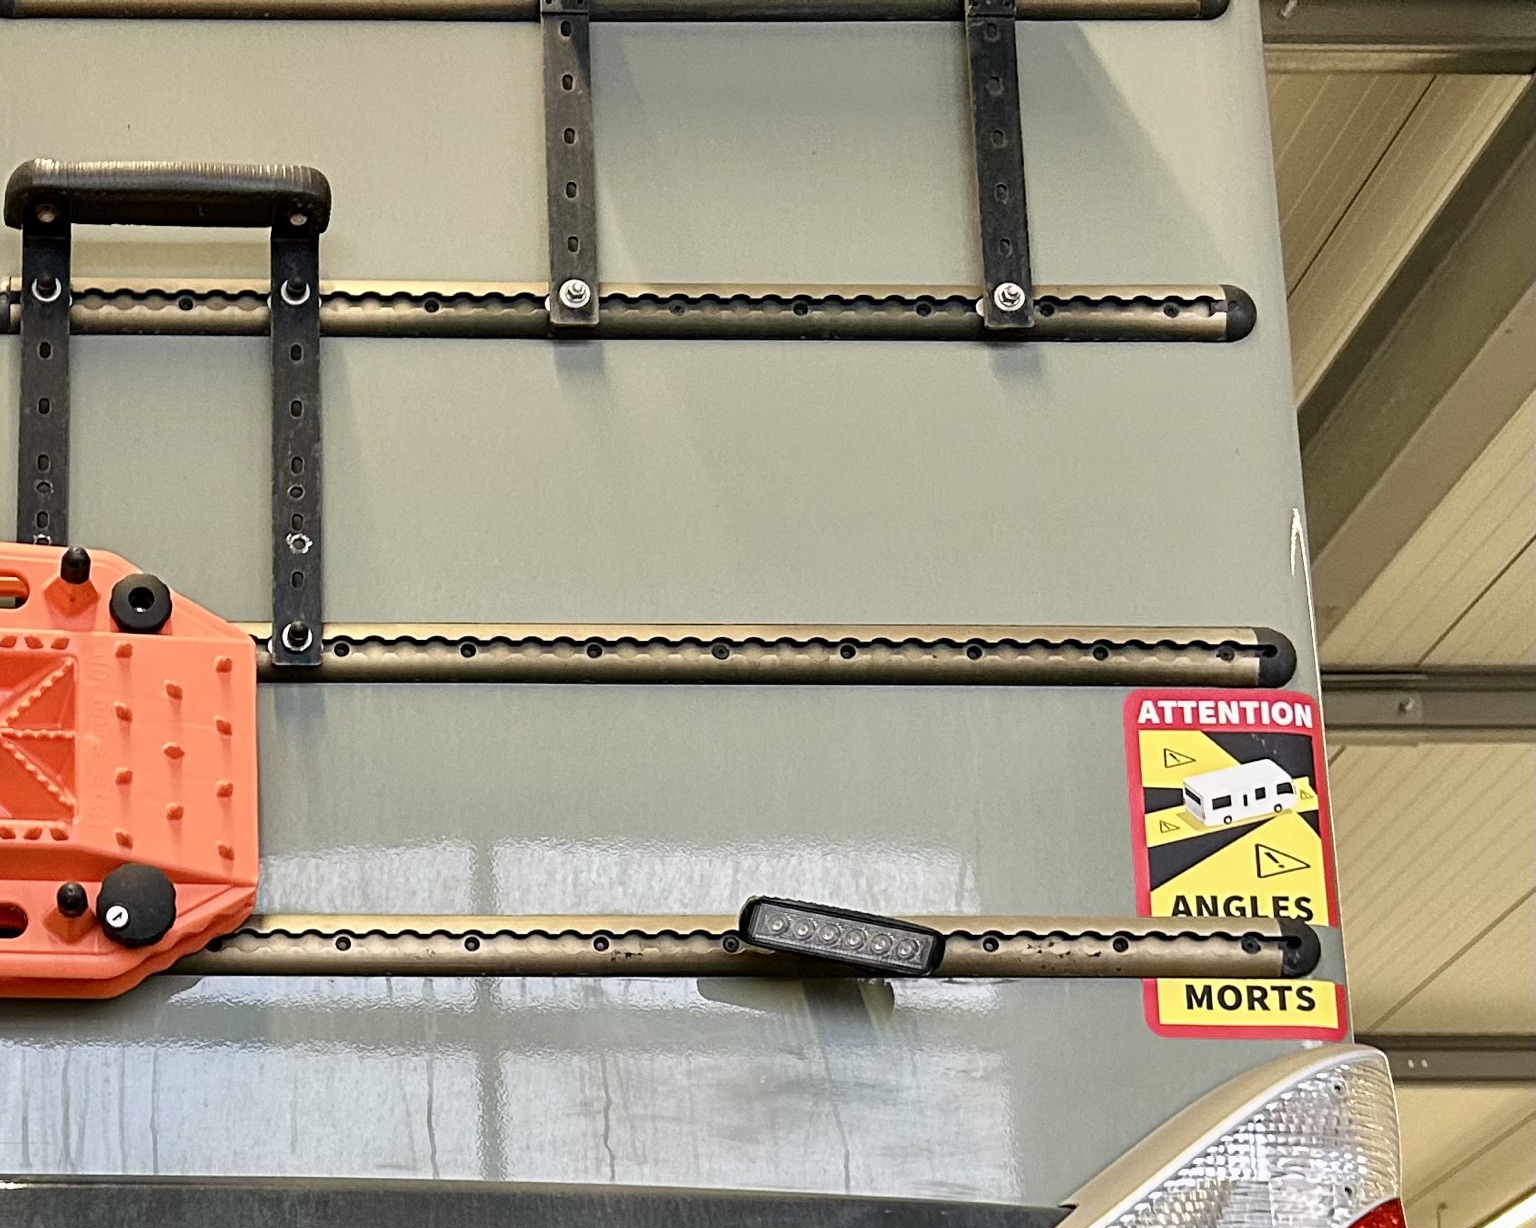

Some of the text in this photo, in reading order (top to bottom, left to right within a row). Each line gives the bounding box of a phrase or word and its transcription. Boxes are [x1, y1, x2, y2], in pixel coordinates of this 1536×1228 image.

[1138, 700, 1313, 728] ATTENTION
[1171, 895, 1314, 922] ANGLES
[1185, 984, 1316, 1011] MORTS
